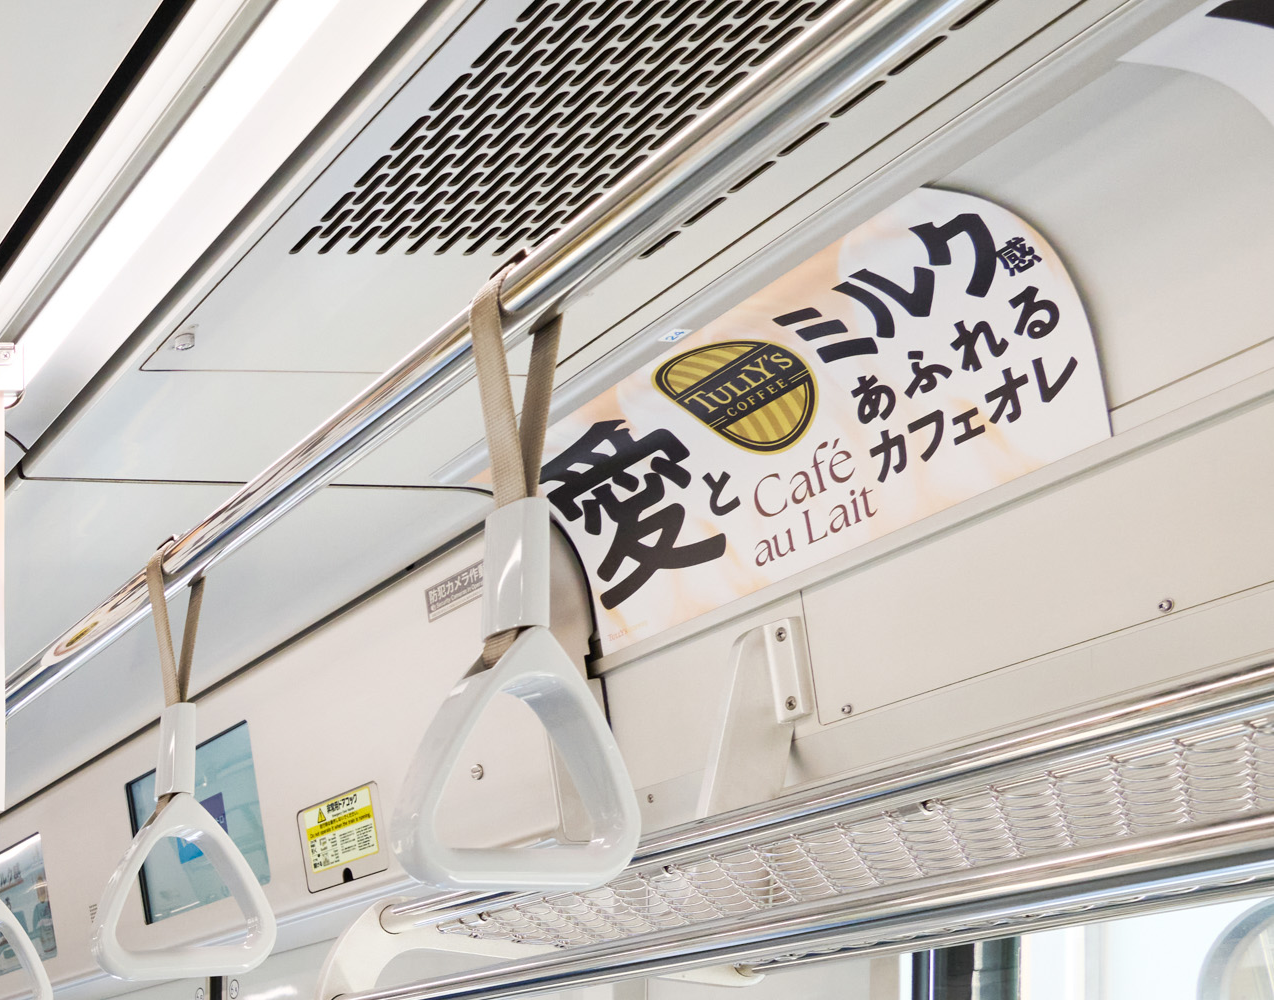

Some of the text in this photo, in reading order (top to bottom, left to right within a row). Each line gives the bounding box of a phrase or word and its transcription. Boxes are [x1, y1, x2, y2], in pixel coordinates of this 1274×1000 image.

[682, 349, 793, 417] TULLY'S
[852, 286, 1060, 424] あふれる
[727, 377, 789, 420] COFFEE
[870, 357, 1078, 482] カフェオレ
[754, 438, 853, 519] Café
[755, 483, 879, 567] au Lait
